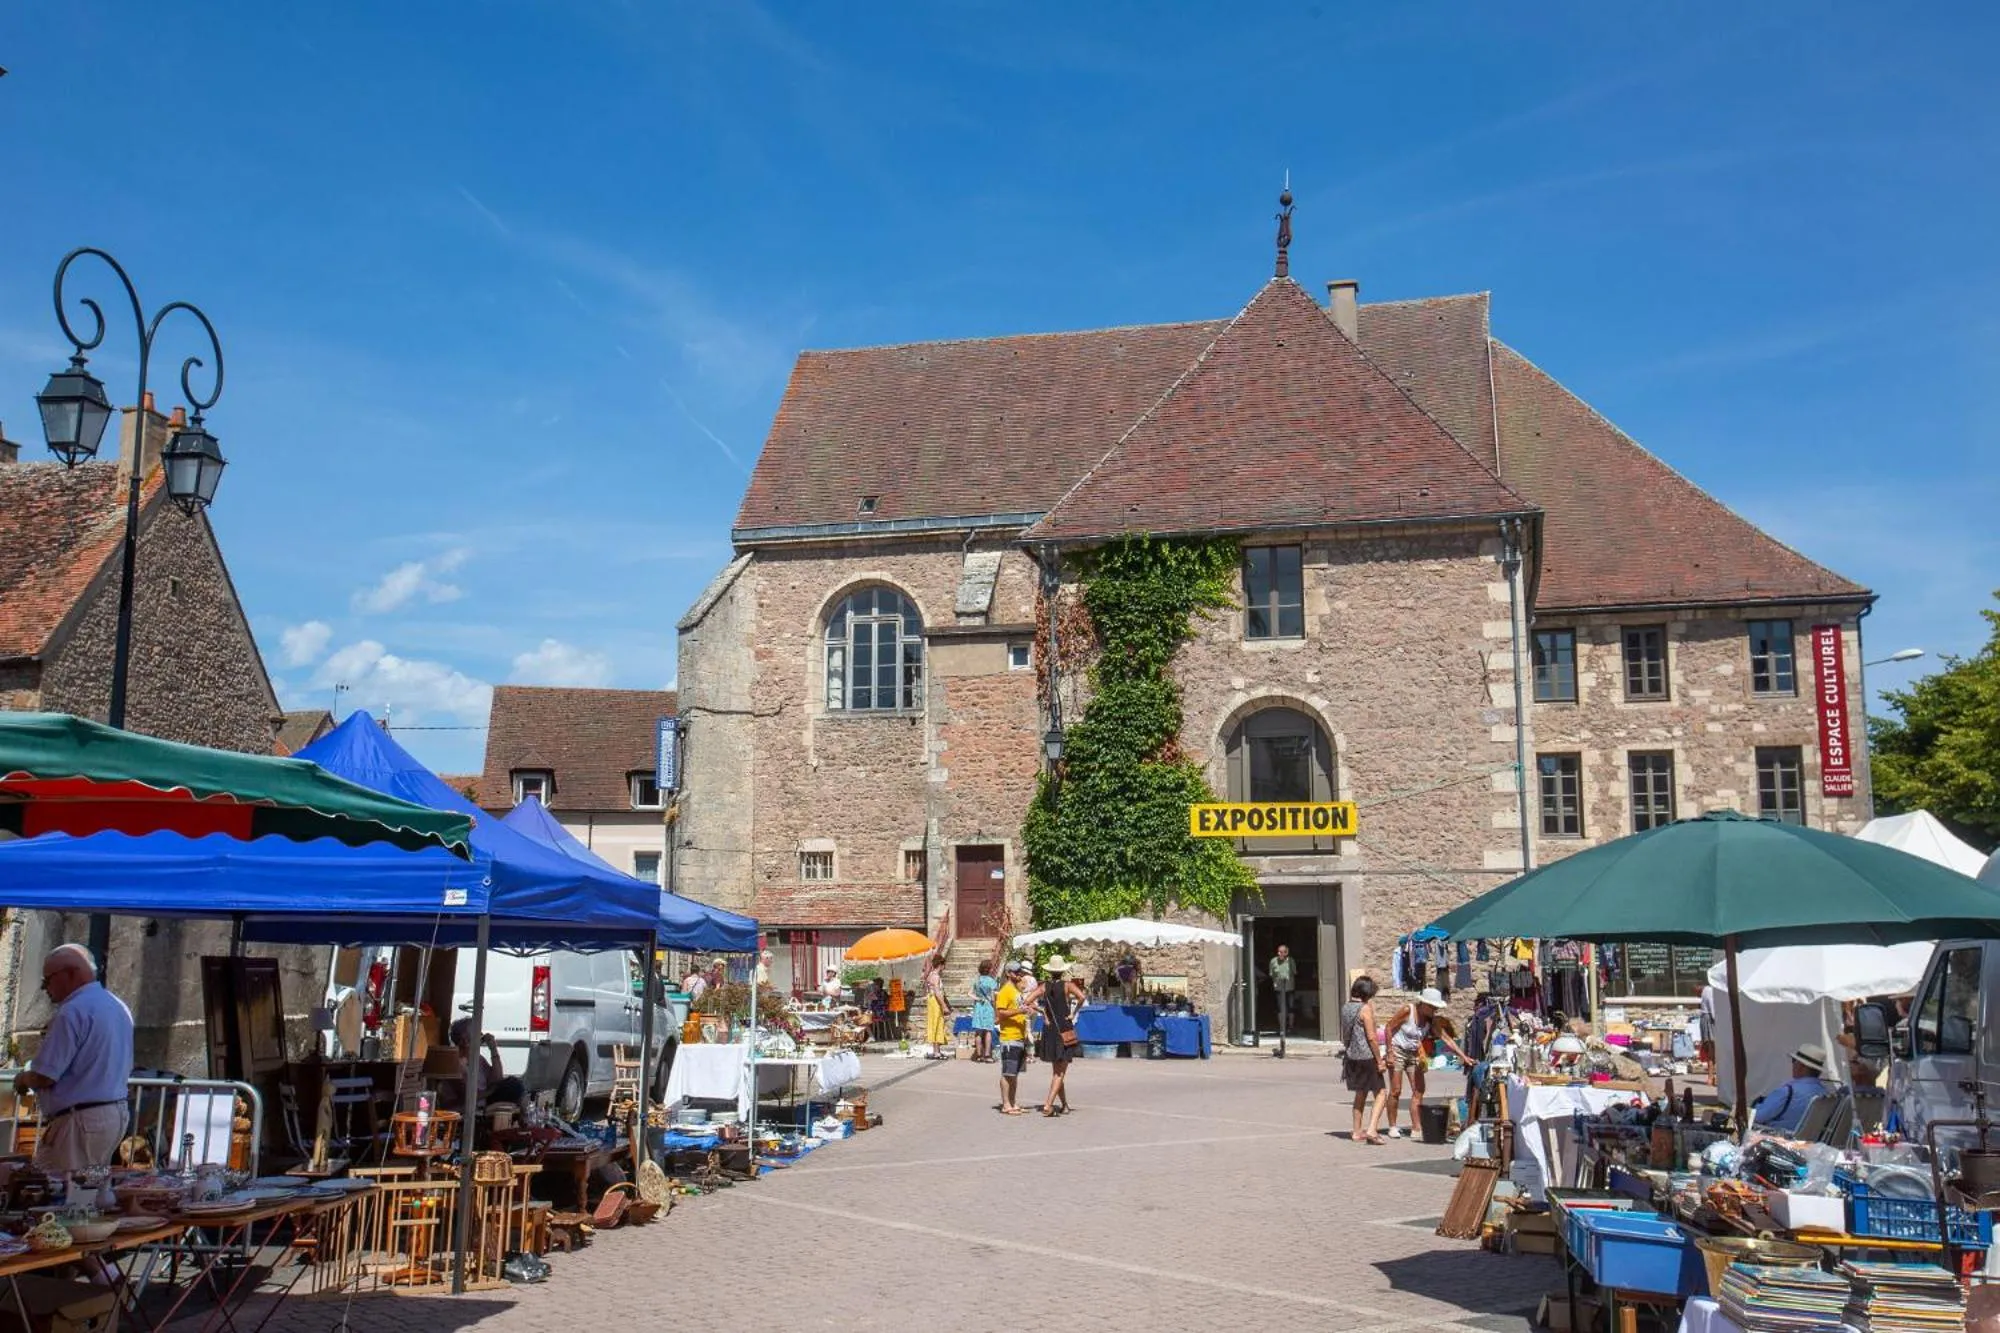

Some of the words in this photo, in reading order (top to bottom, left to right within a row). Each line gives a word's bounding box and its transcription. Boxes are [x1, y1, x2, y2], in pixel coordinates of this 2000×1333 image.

[1821, 628, 1838, 704] CULTUREL
[1827, 708, 1843, 766] ESPACE
[1200, 807, 1348, 831] EXPOSITION
